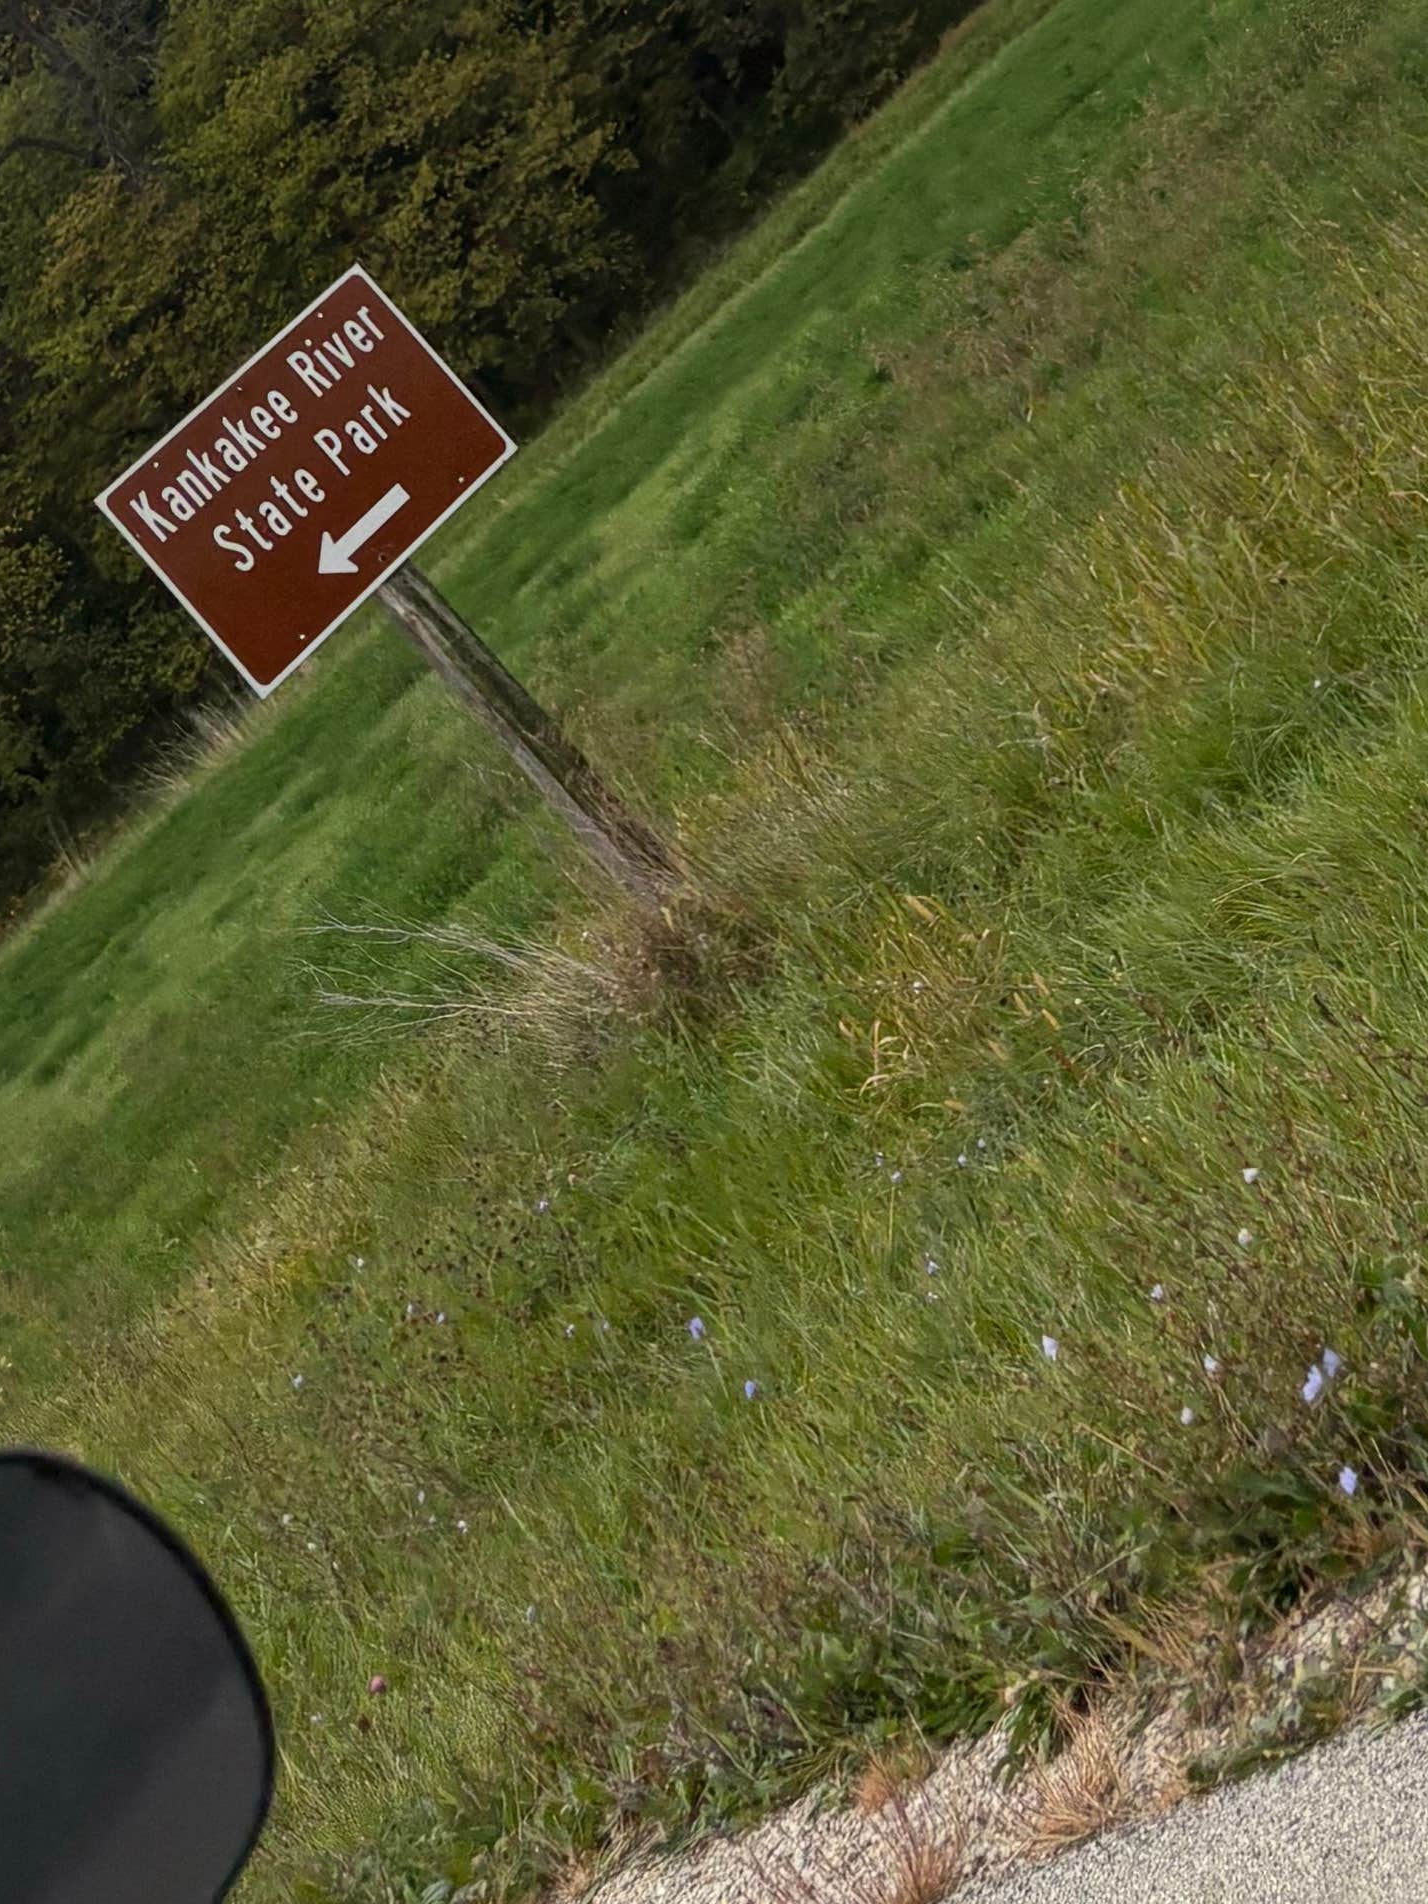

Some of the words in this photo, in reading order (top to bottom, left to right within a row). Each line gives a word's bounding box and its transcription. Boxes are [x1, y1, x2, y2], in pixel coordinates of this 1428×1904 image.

[129, 388, 299, 543] Kankakee
[285, 305, 385, 398] River
[212, 467, 326, 572] State
[313, 383, 412, 476] Park
